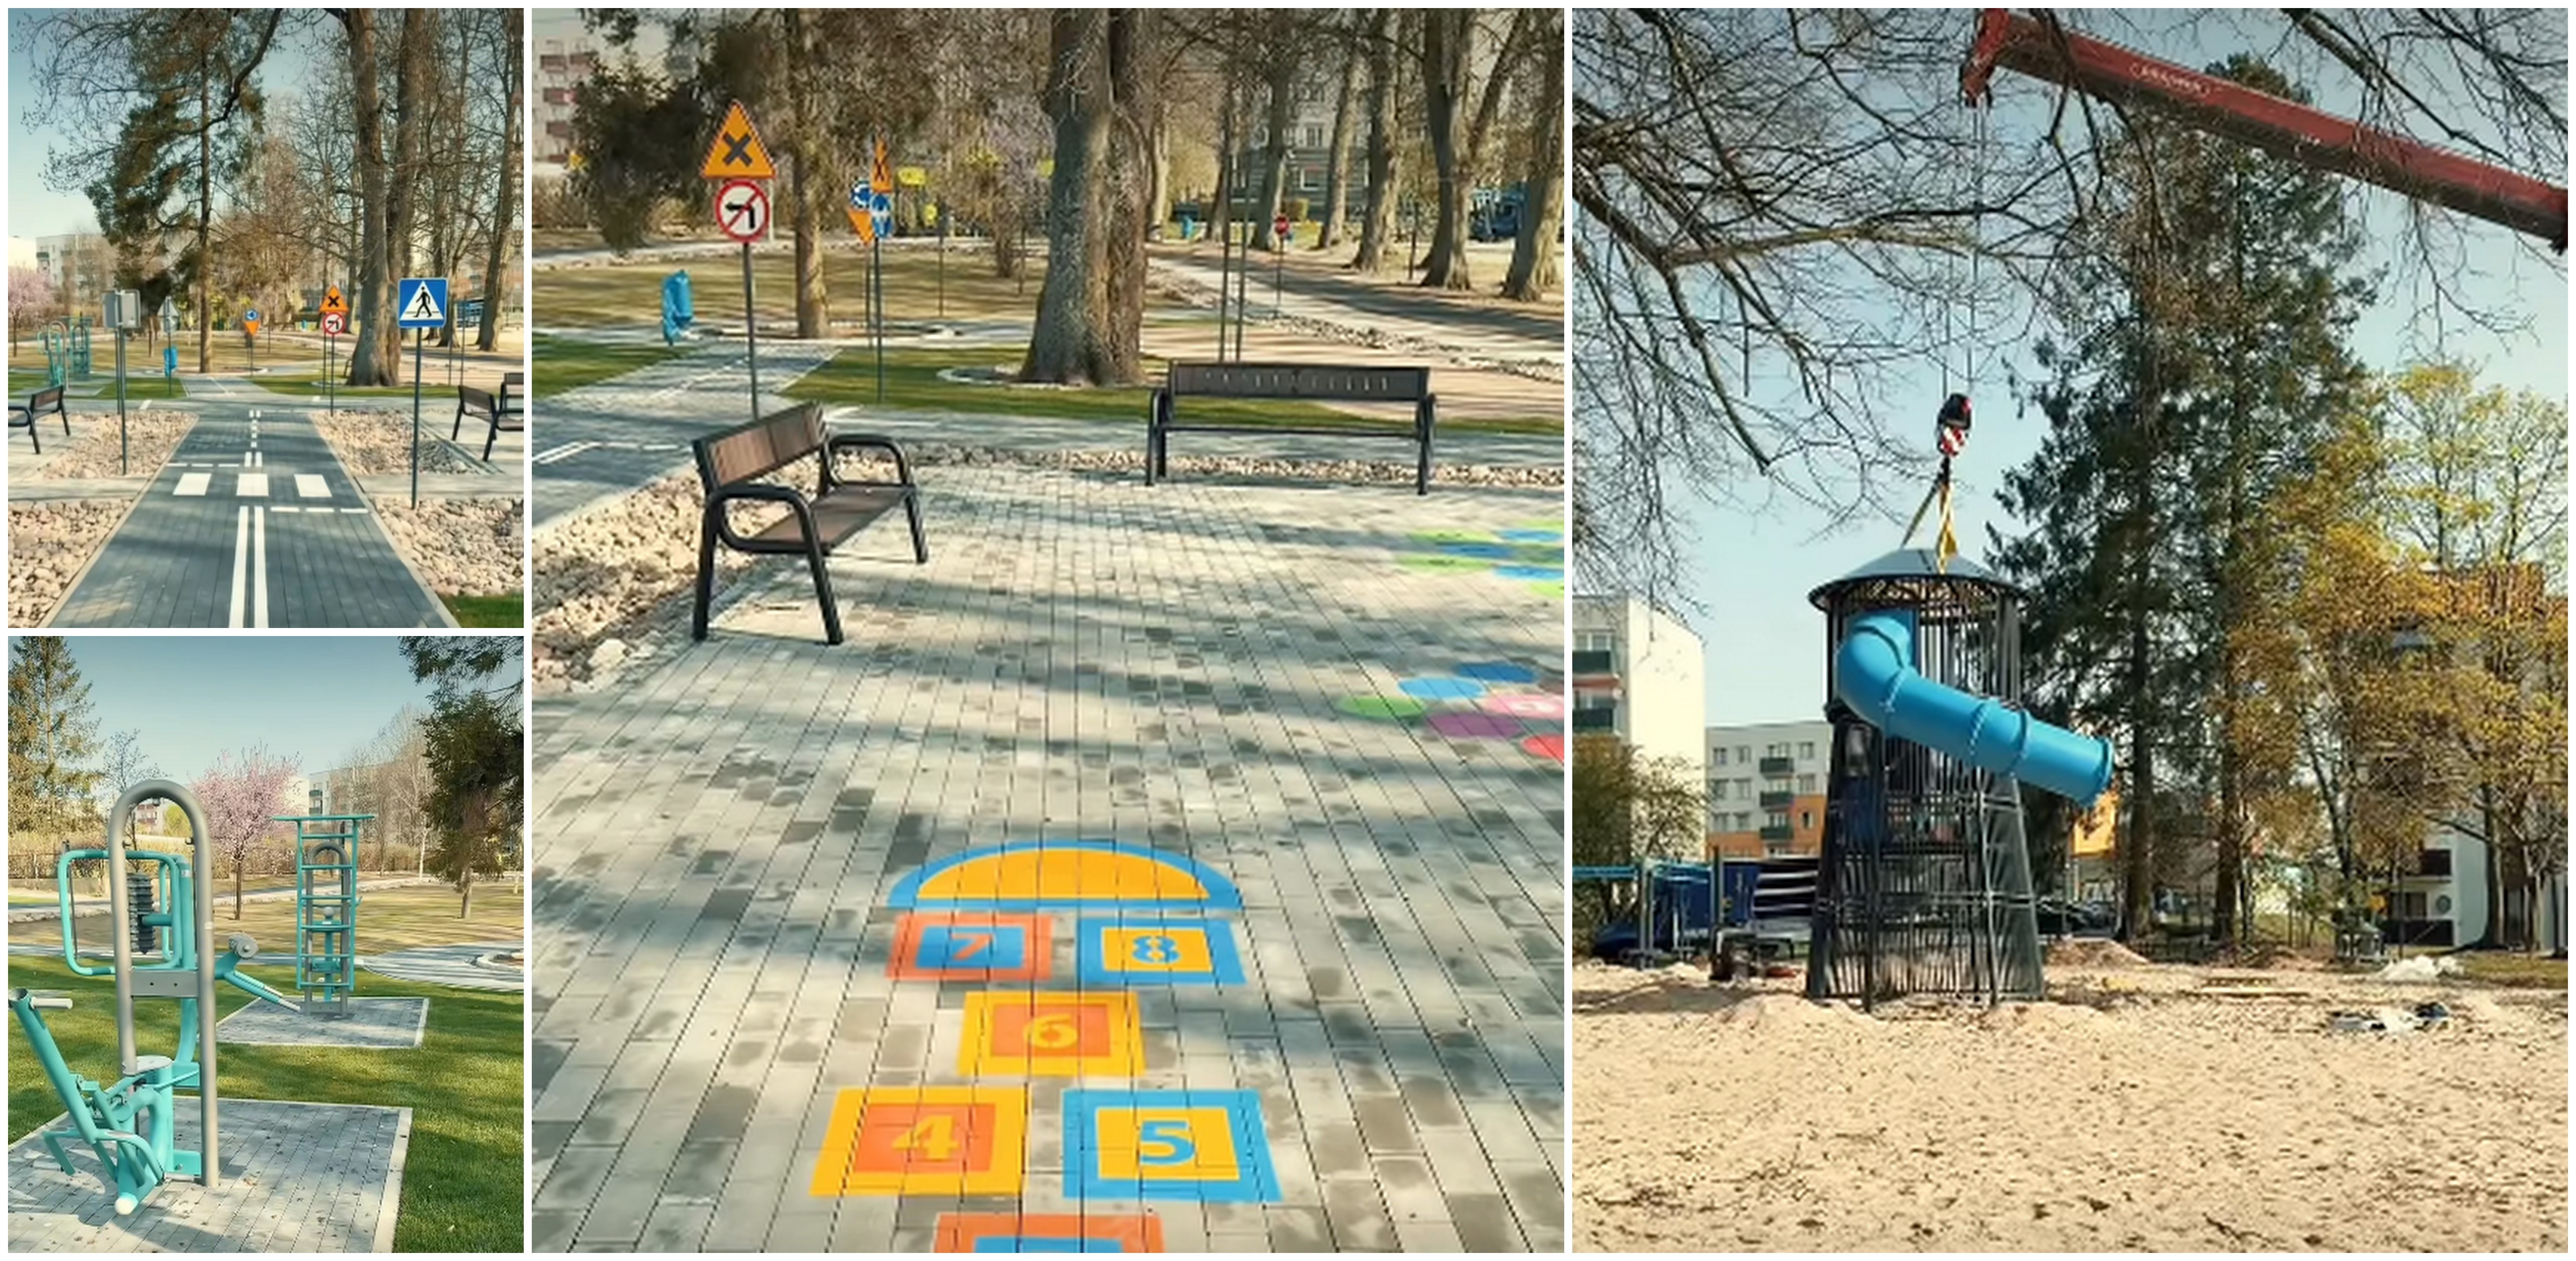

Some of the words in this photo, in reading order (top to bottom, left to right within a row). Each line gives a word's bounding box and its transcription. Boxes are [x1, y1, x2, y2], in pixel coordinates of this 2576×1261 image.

[951, 934, 994, 960] 7
[1132, 935, 1181, 964] 8
[1024, 1013, 1079, 1048] 6
[892, 1115, 959, 1159] 4
[1139, 1121, 1195, 1164] 5
